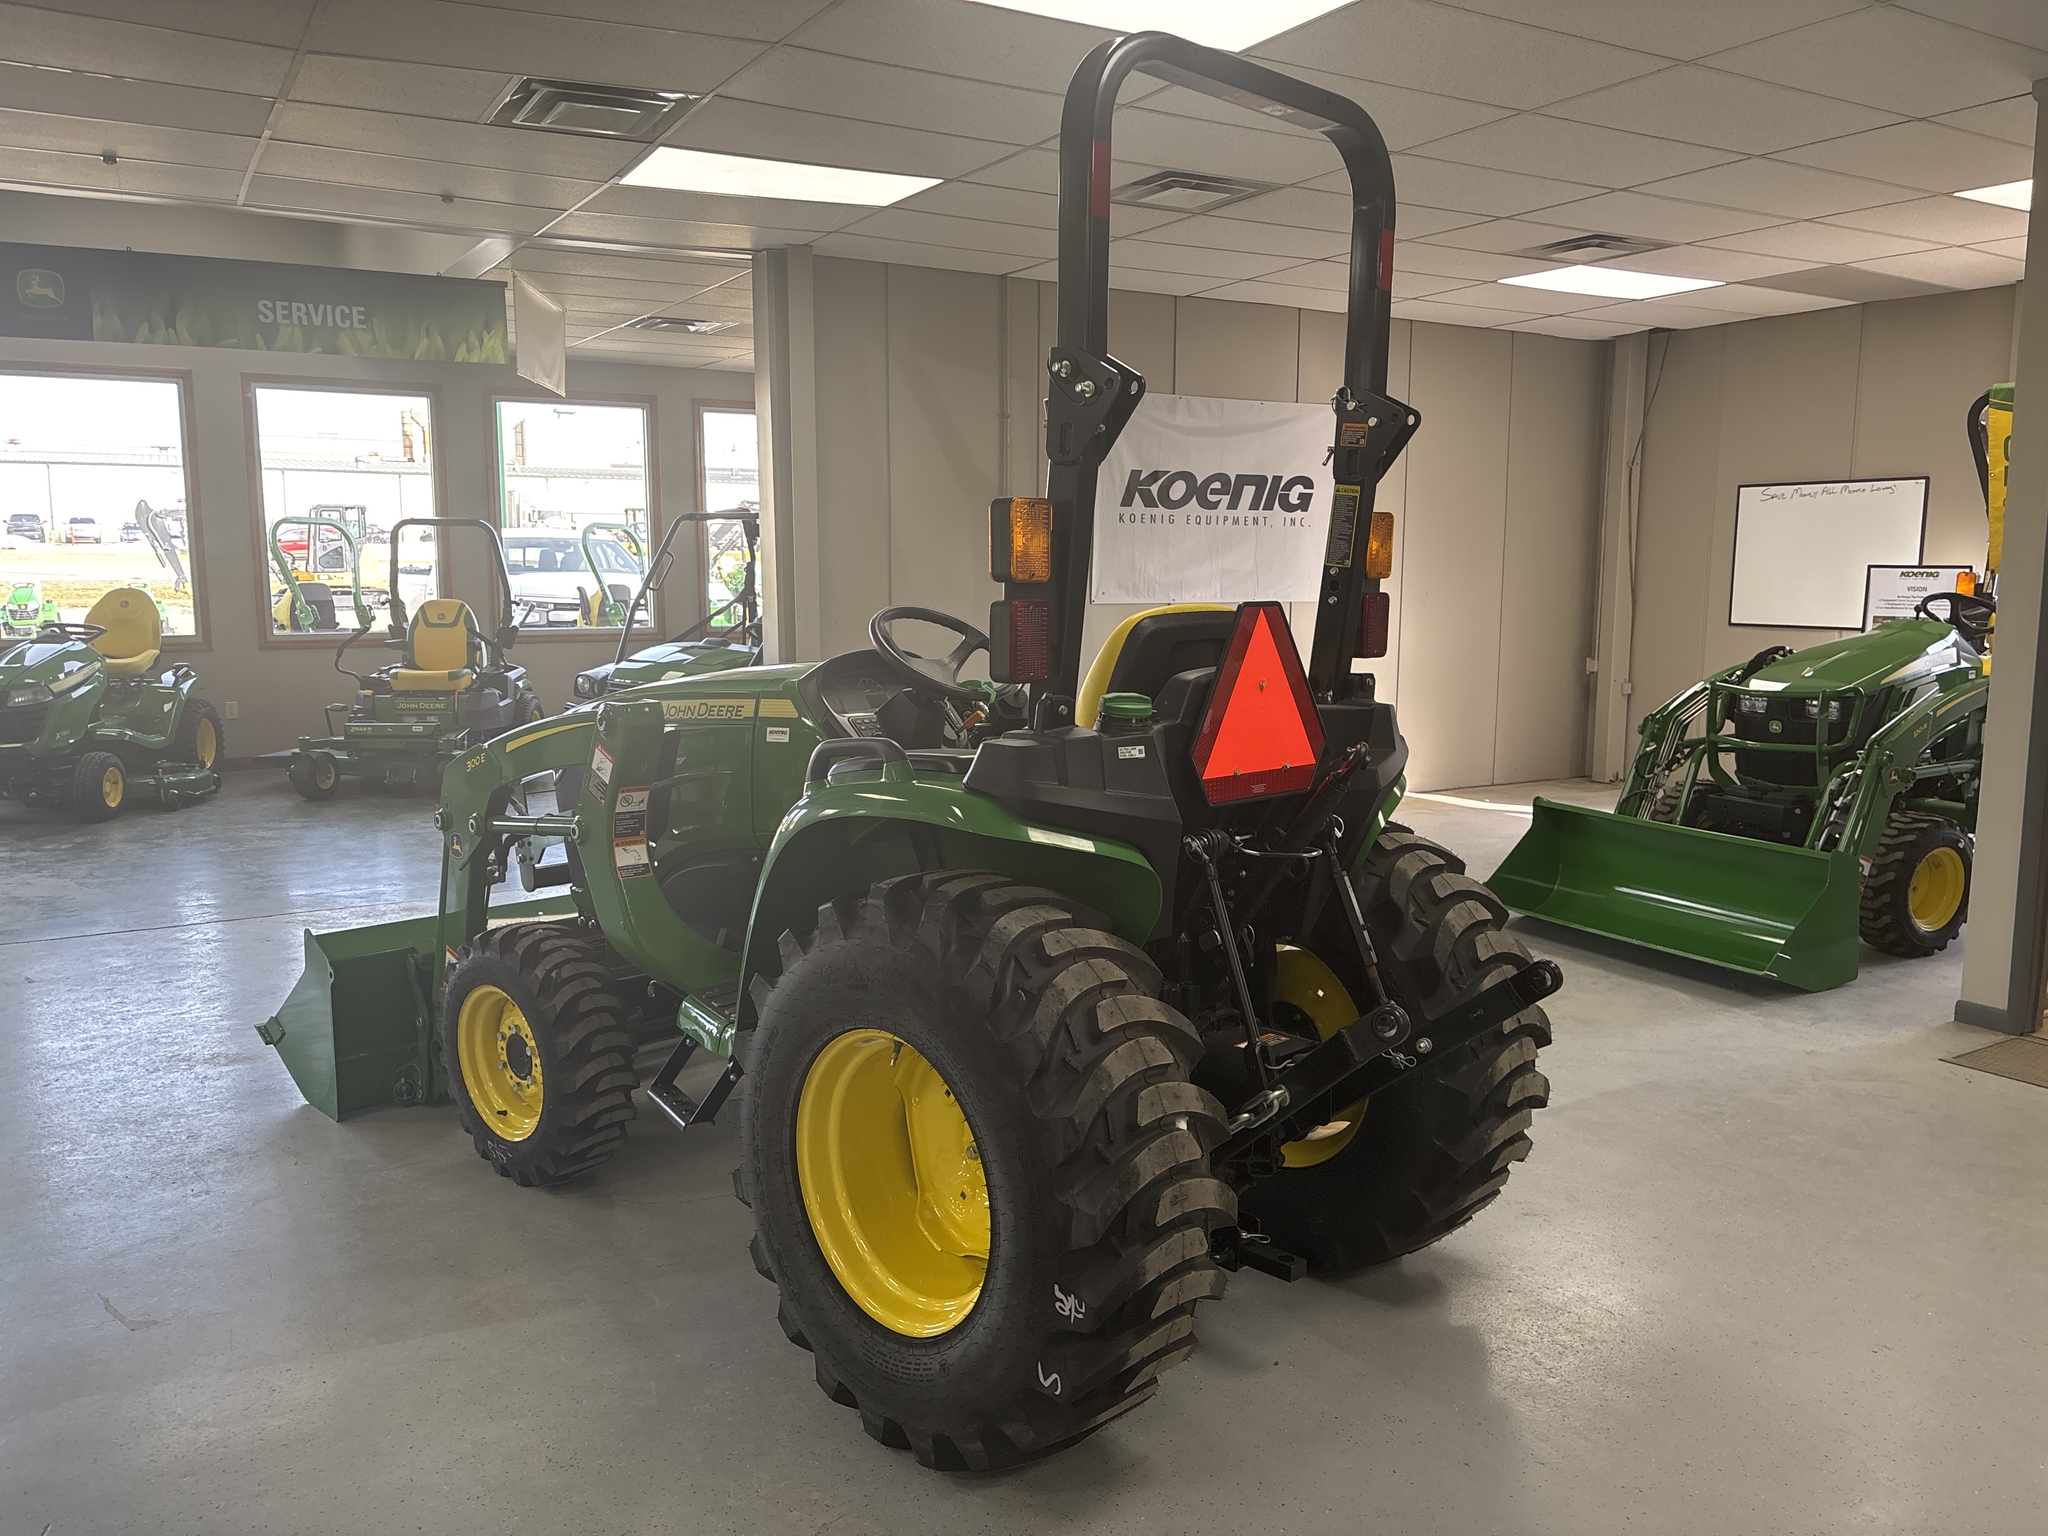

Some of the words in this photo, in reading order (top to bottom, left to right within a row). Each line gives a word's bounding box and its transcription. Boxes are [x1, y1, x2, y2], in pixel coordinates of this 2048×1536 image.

[257, 299, 367, 329] SERVICE
[1340, 487, 1360, 495] CAUTION
[1118, 513, 1176, 525] KOENIG
[1186, 514, 1273, 528] EQUIPMENT,
[1283, 516, 1311, 528] INC.
[1906, 585, 1928, 593] VISION
[664, 703, 696, 718] JOHN
[698, 702, 745, 718] DEERE
[620, 838, 646, 847] WARNING
